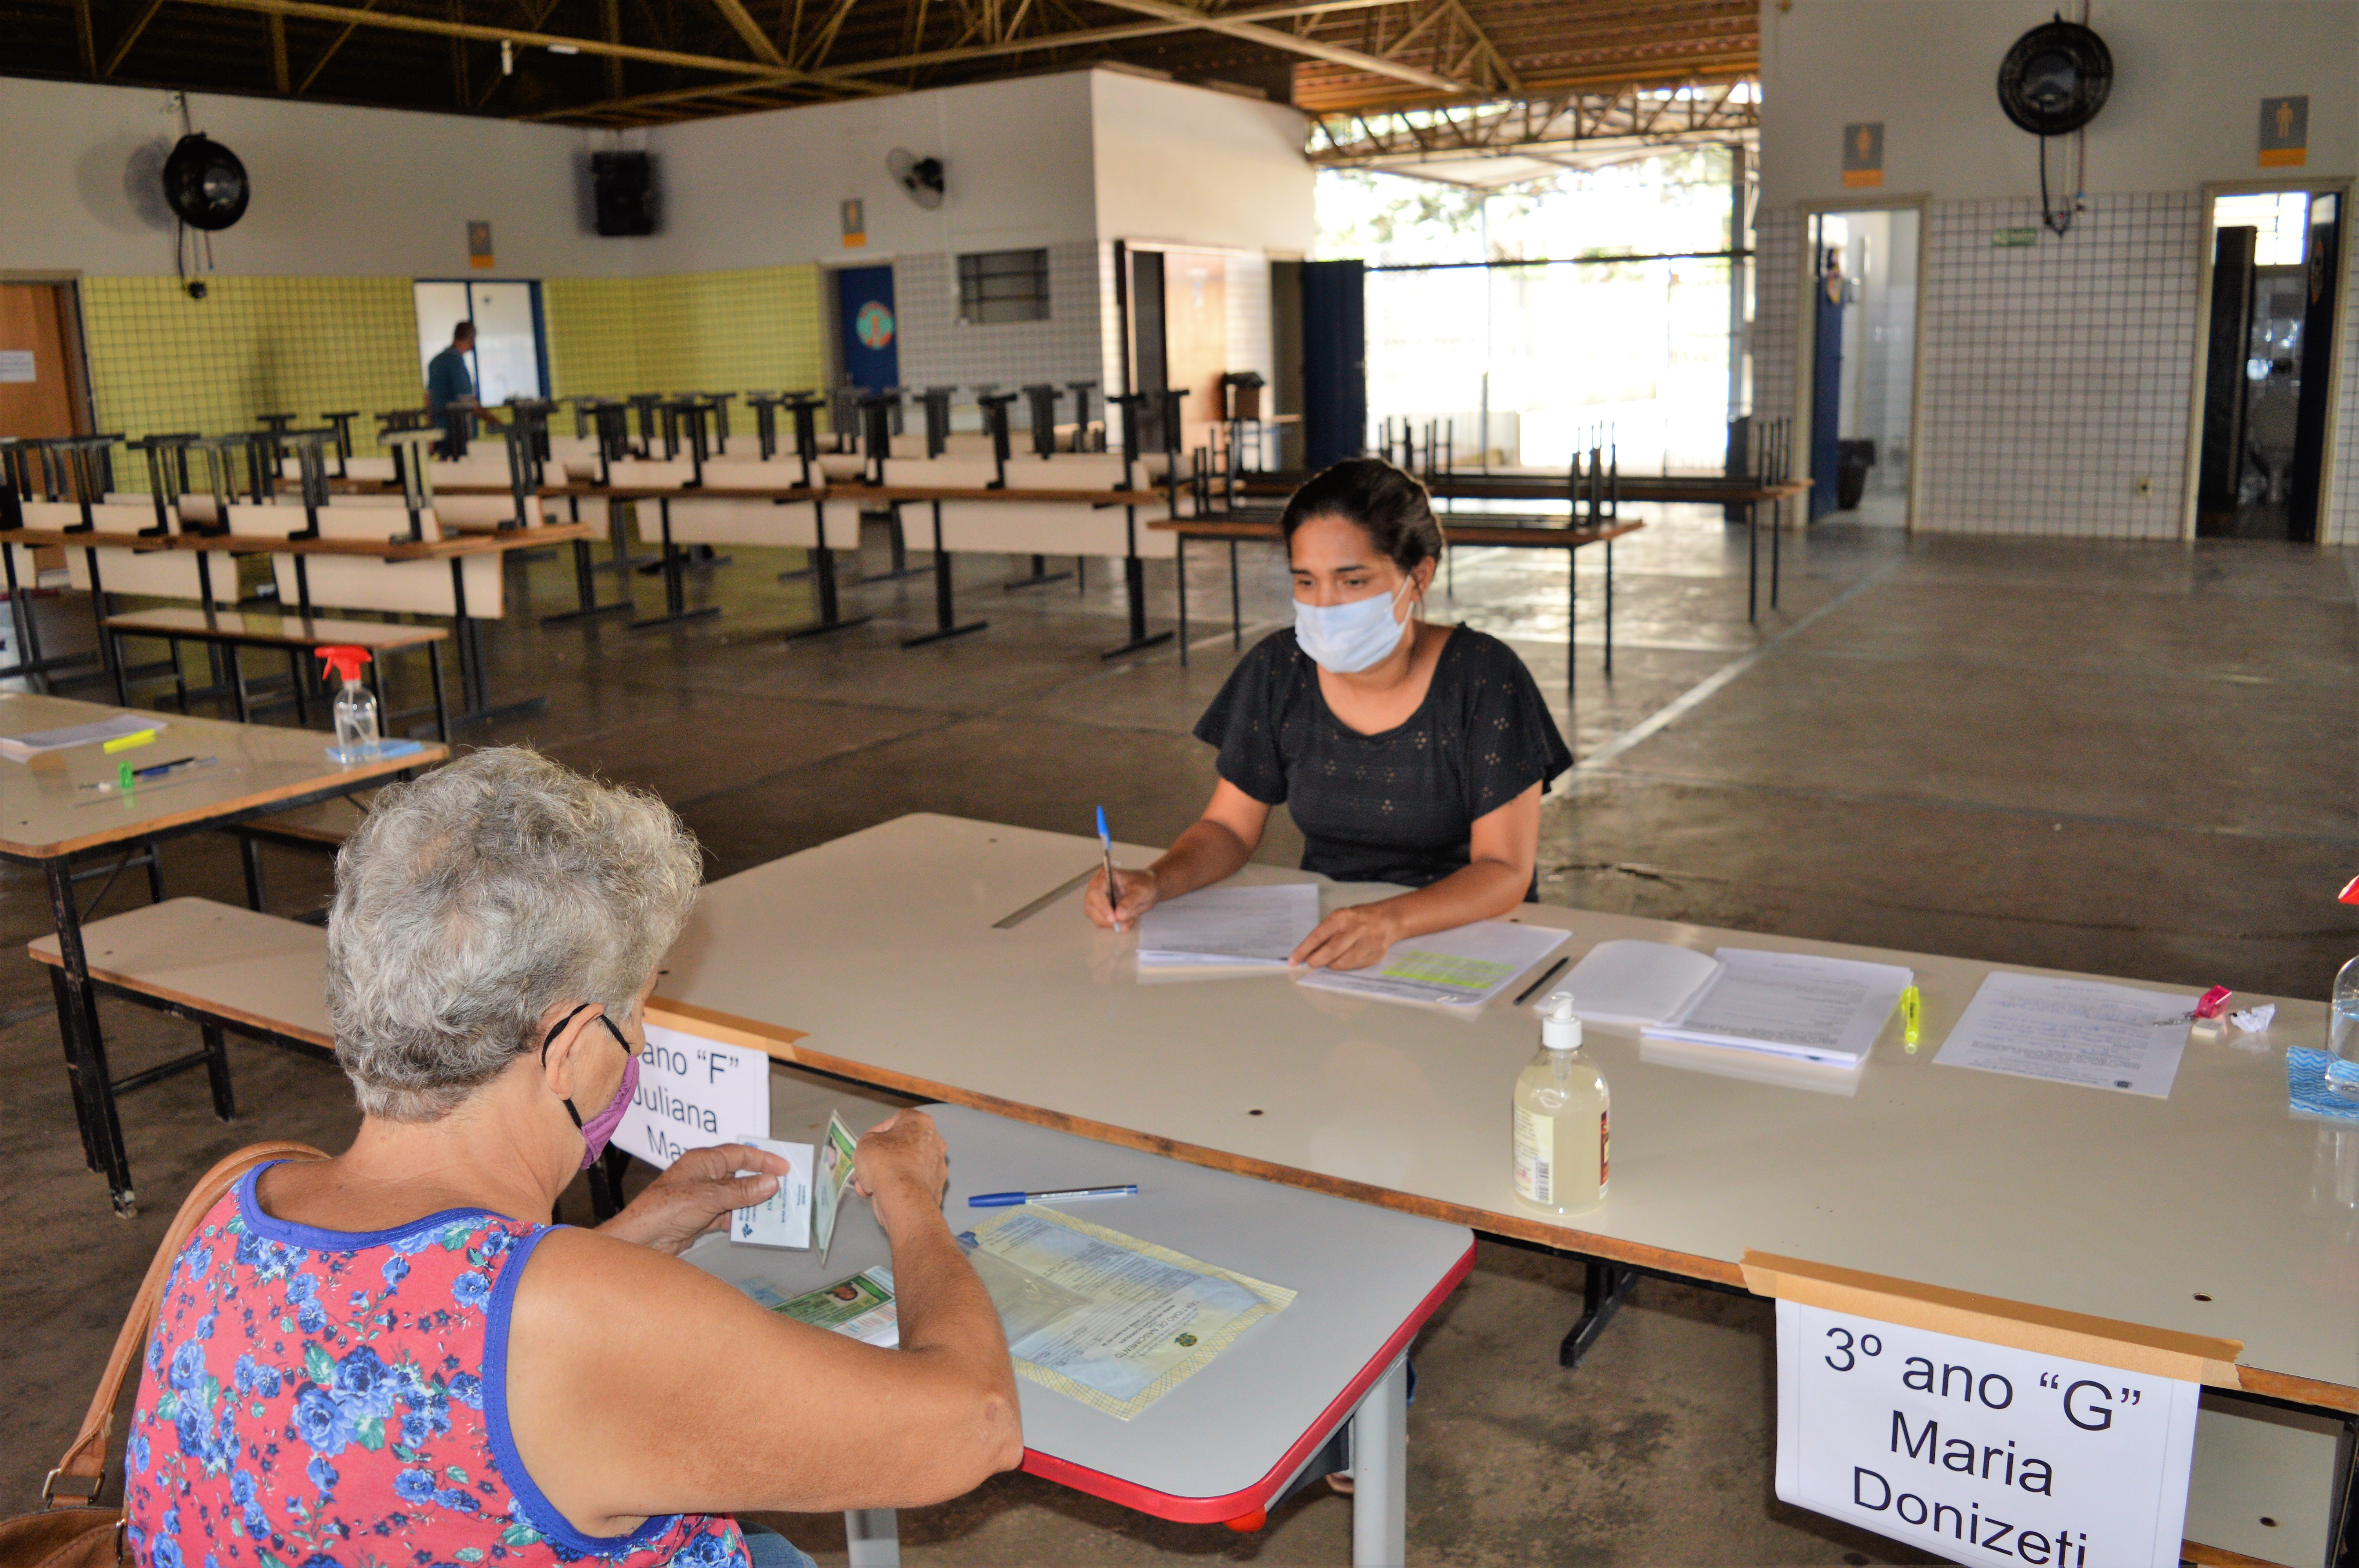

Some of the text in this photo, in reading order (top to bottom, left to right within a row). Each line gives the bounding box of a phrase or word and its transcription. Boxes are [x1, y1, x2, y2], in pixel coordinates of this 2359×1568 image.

[642, 1042, 739, 1084] ano “F”
[632, 1081, 718, 1135] Juliana
[646, 1125, 689, 1162] Ma
[1825, 1327, 2141, 1432] 3º ano “G”
[1891, 1410, 2052, 1497] Maria
[1854, 1466, 2087, 1568] Donizeti
